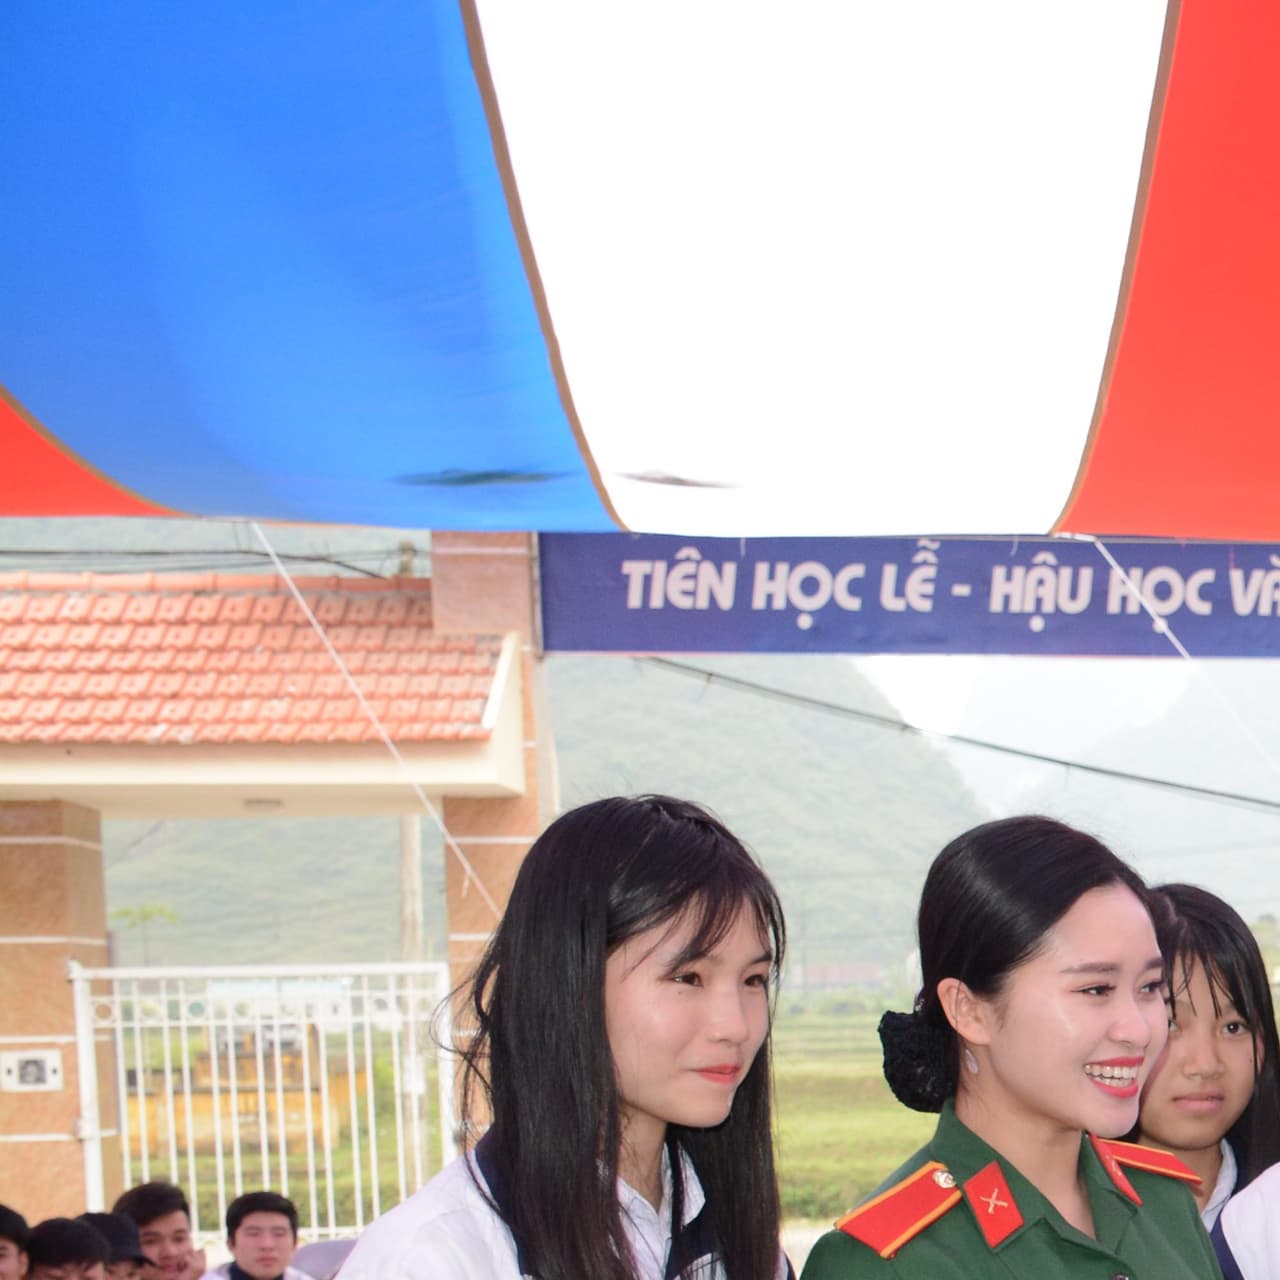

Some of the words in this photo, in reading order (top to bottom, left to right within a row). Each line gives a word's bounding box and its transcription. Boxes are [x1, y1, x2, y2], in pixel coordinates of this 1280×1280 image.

[621, 546, 737, 610] TIÊN
[751, 560, 867, 630] HỌC
[879, 536, 941, 612] LỄ
[988, 550, 1094, 633] HẬU
[1106, 565, 1216, 634] HỌC
